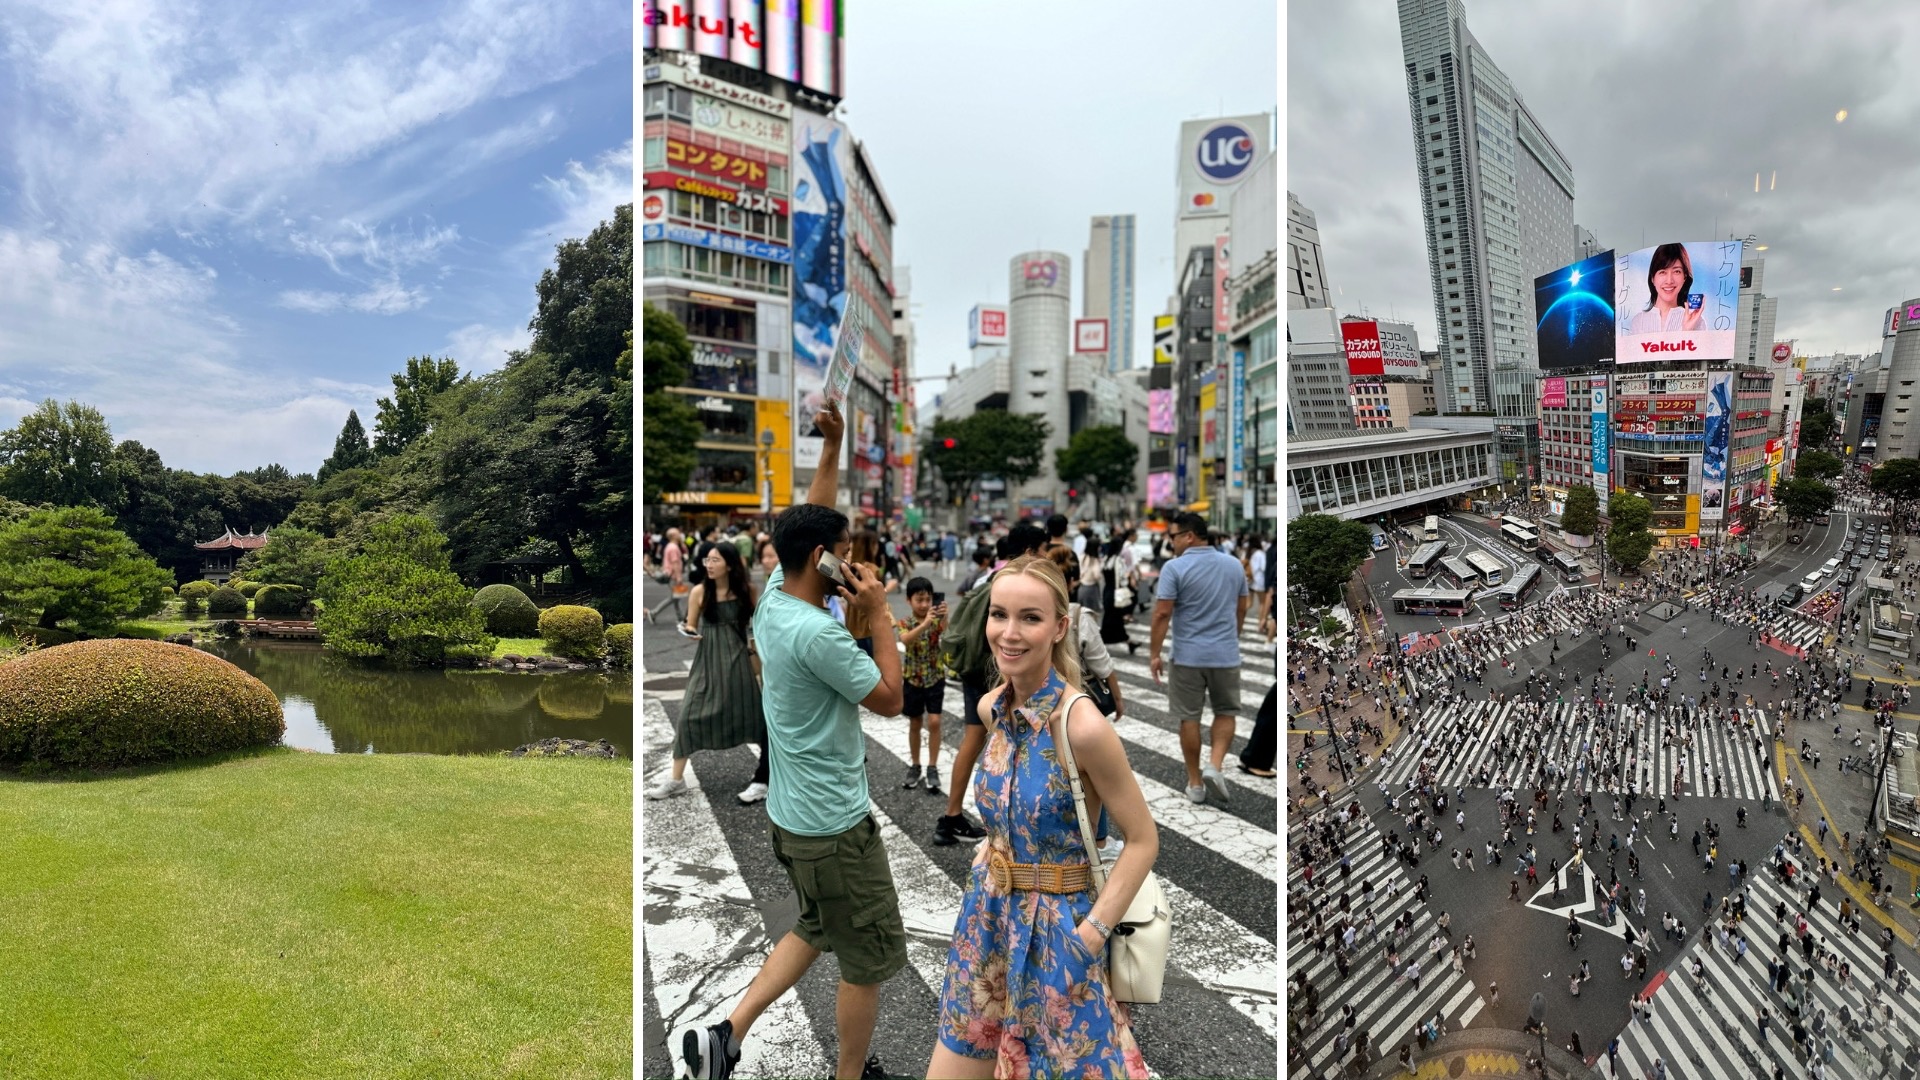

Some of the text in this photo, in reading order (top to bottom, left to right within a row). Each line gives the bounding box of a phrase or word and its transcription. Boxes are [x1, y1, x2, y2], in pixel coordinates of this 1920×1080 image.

[643, 3, 762, 48] akult
[683, 72, 786, 113] しゃぶしゃぶバイキング
[667, 140, 765, 181] コンタクト
[736, 191, 780, 214] ガスト
[1714, 241, 1736, 331] ヤクルトの
[1618, 254, 1631, 337] ヨーグルト
[1346, 339, 1378, 350] カラオケ
[1641, 340, 1697, 352] Yakult
[1348, 351, 1381, 359] JOYSOUND
[1383, 359, 1418, 367] JOYSOUND
[1656, 401, 1695, 409] コンタクト
[1630, 423, 1646, 432] ガスト
